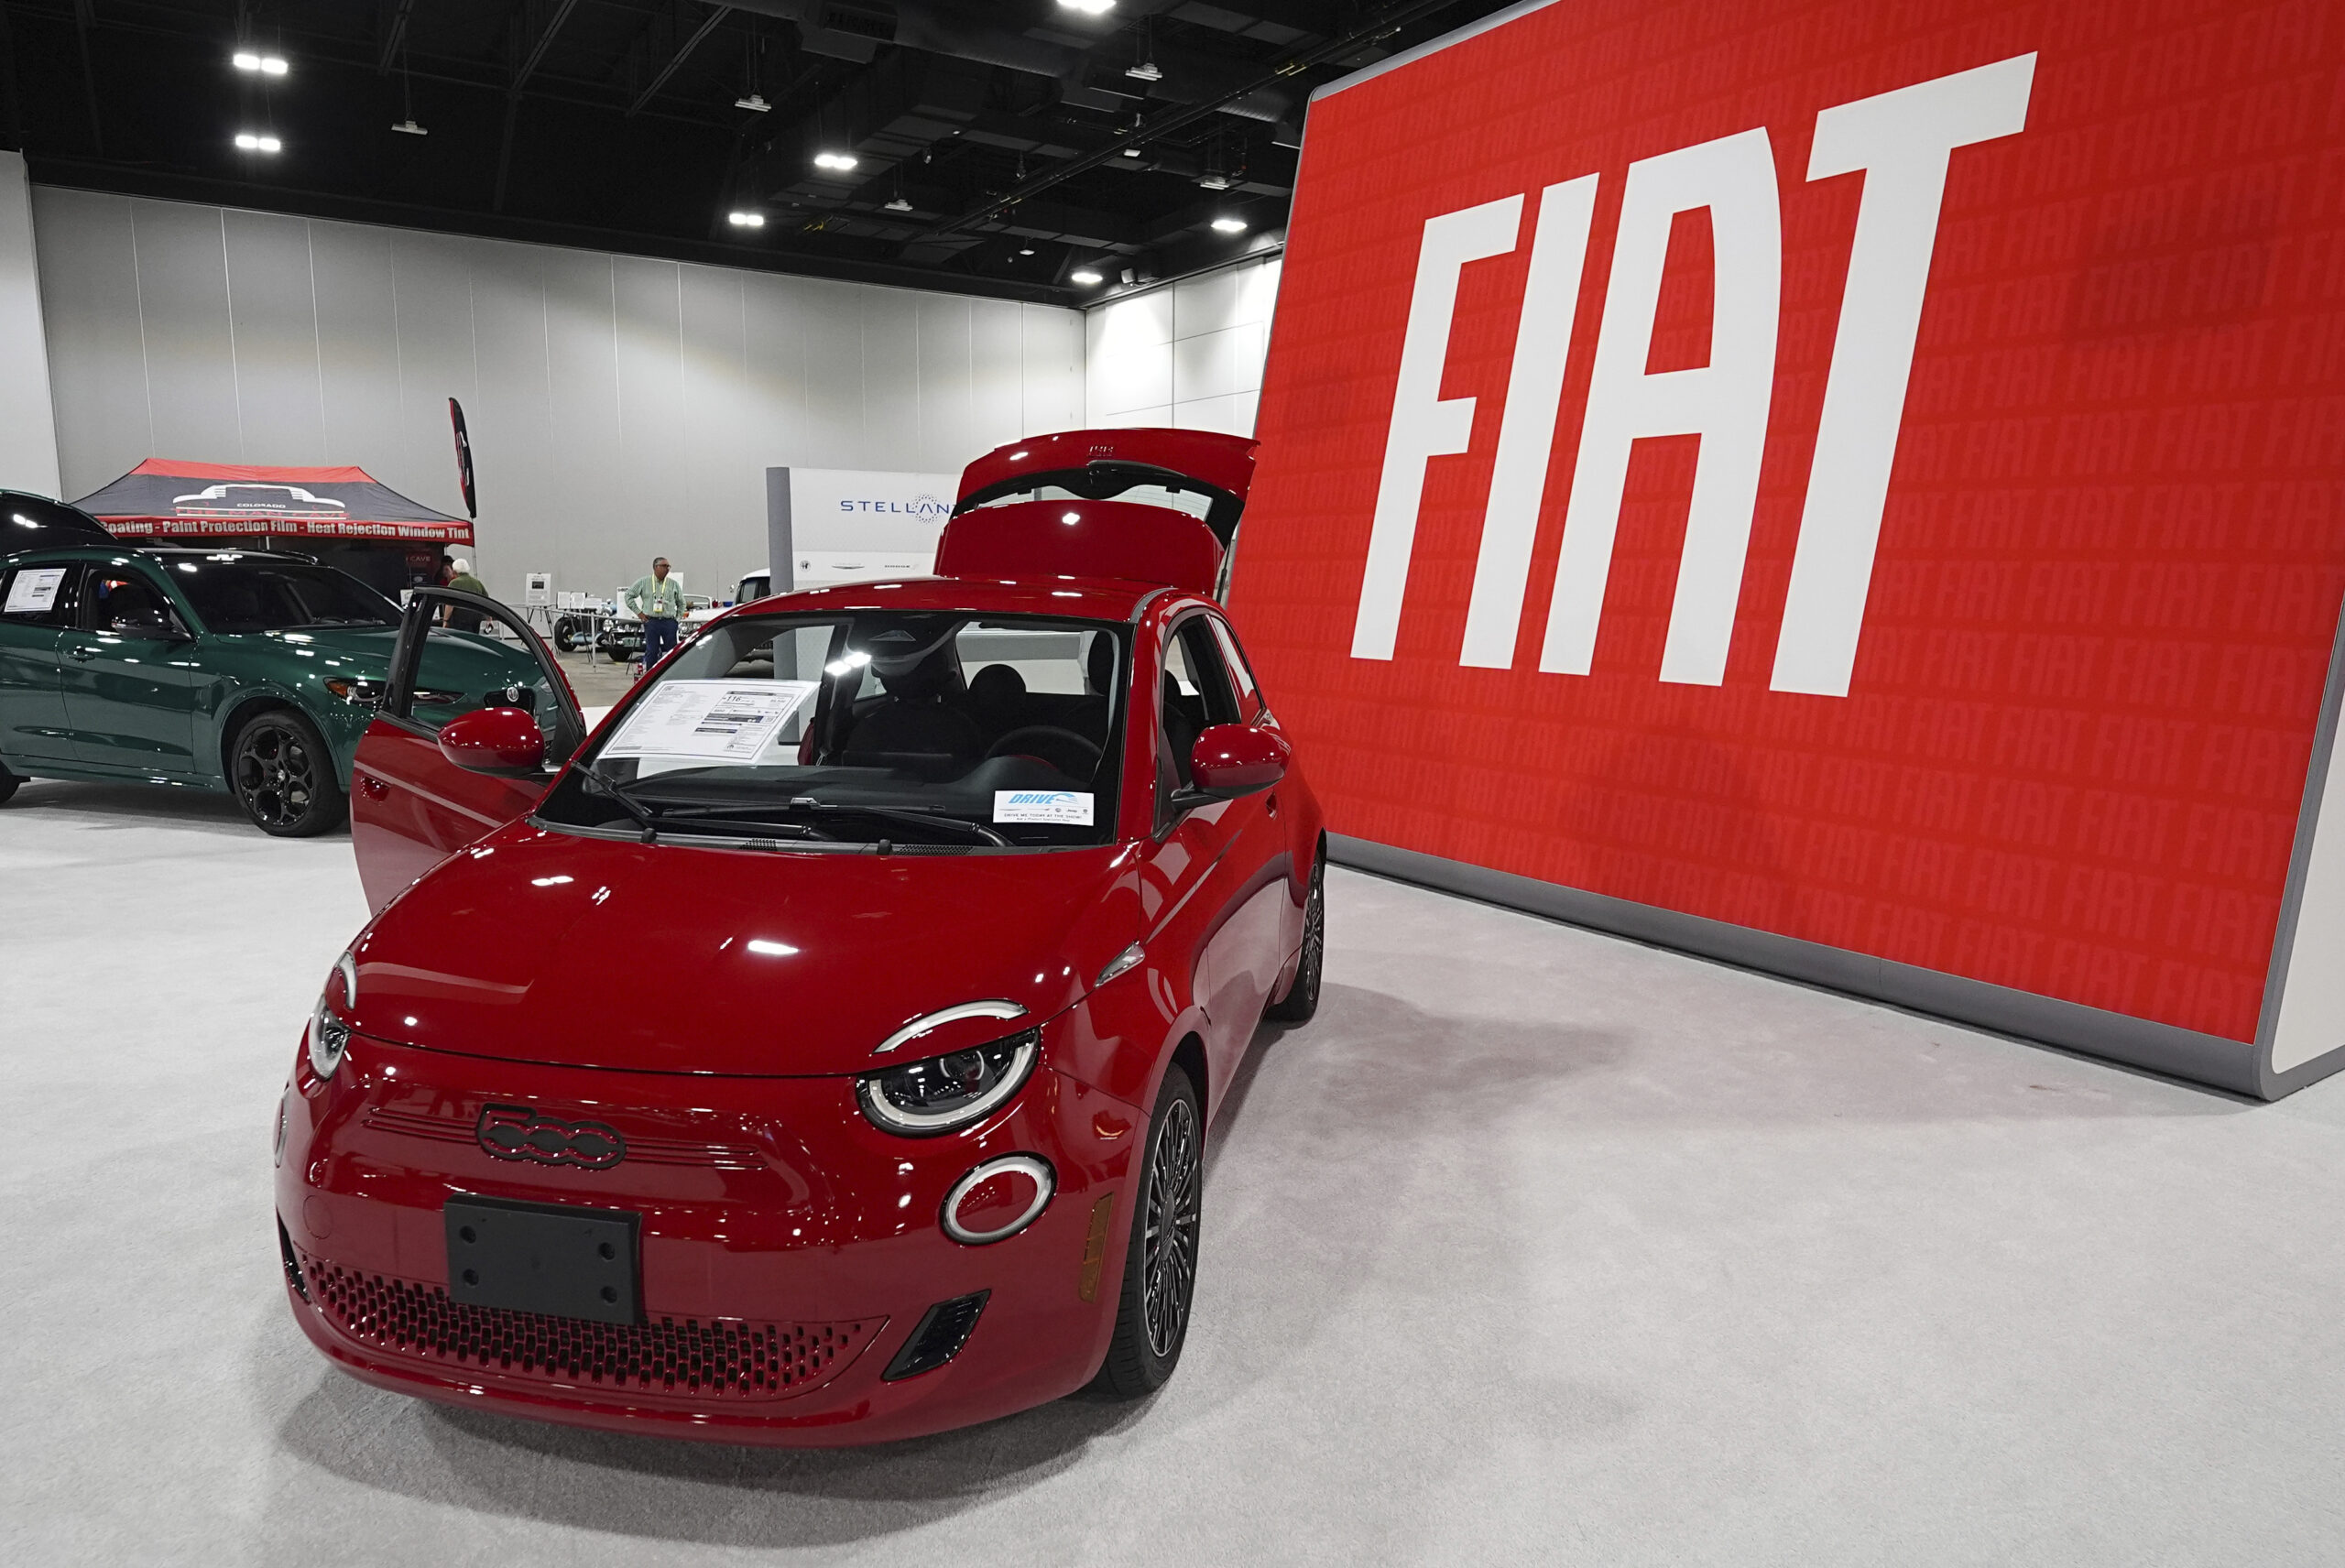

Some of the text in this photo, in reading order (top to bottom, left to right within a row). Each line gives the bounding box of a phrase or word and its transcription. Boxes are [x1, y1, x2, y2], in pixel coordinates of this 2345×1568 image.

[1351, 51, 2037, 696] FIAT
[840, 500, 956, 514] STELLAN
[162, 520, 199, 533] Paint
[201, 519, 268, 533] Protection
[270, 520, 298, 532] Film
[307, 521, 336, 534] Heat
[338, 522, 396, 536] Rejection
[398, 525, 445, 538] Window
[446, 527, 470, 539] Tint
[1008, 793, 1056, 804] DRIVE
[477, 1103, 627, 1169] 500
